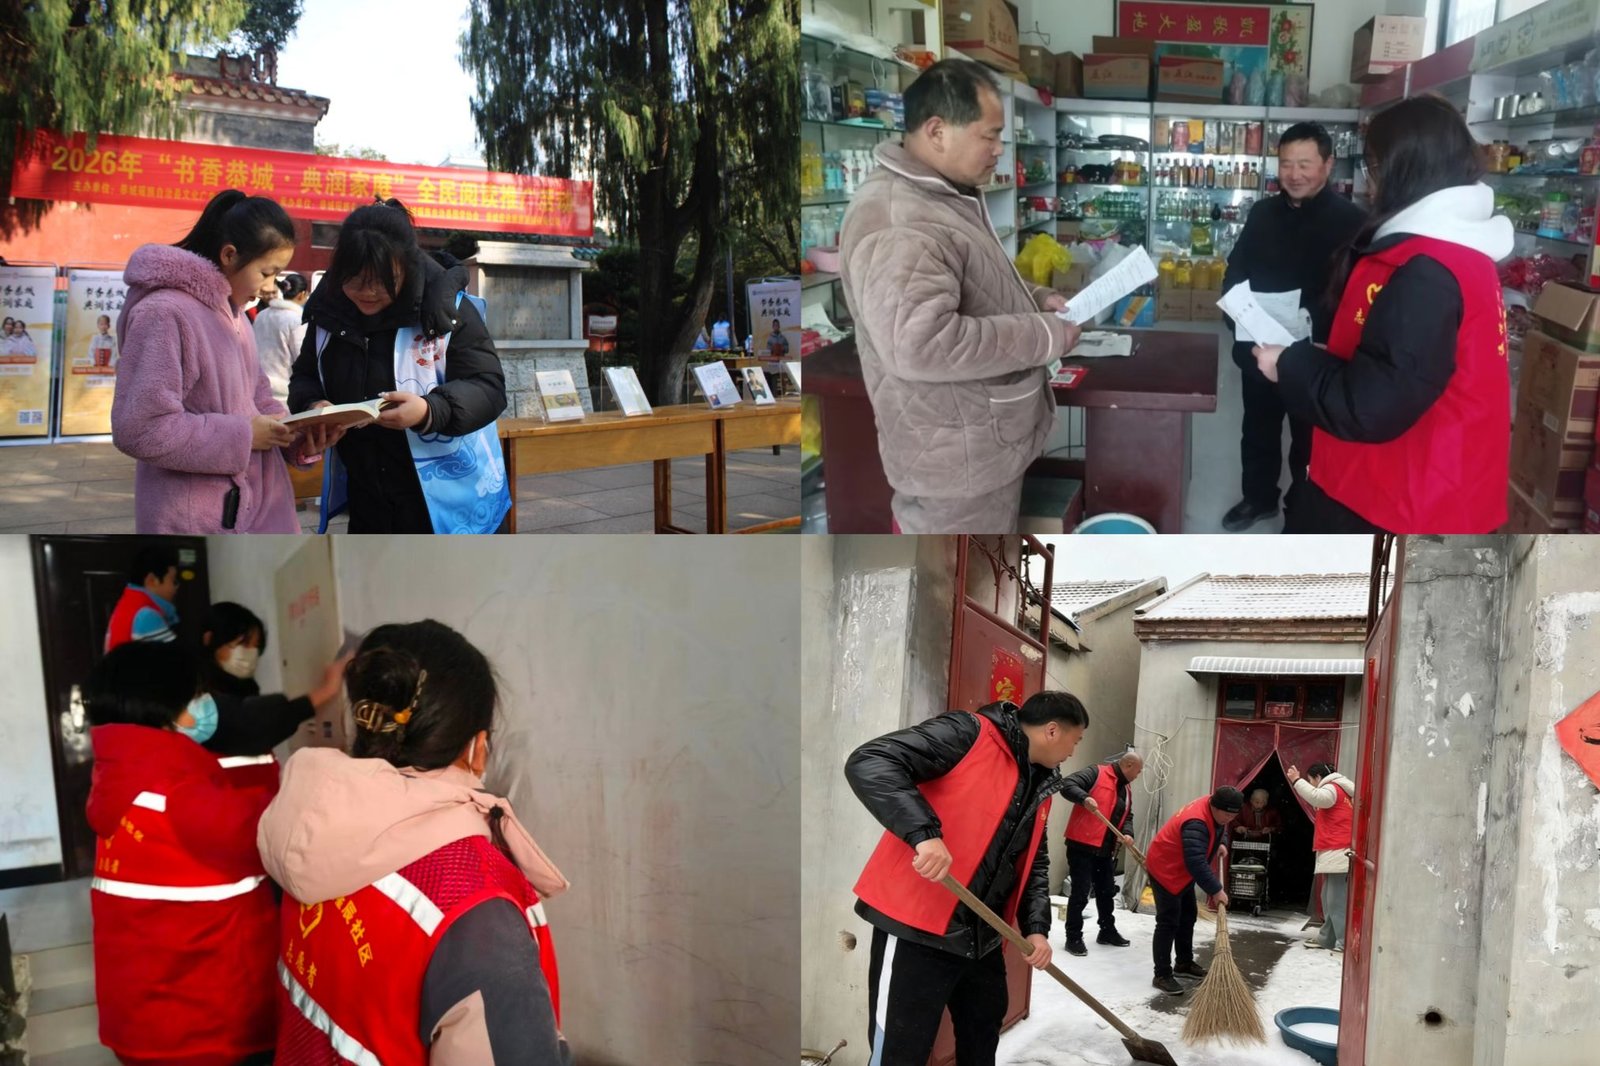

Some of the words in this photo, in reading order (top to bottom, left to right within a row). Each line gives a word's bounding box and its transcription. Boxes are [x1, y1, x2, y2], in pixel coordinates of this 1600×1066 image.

[51, 145, 144, 181] 2026年
[158, 152, 405, 199] “书香恭城·典润家庭”
[416, 176, 574, 214] 全民阅读推广活动
[286, 938, 317, 989] 志愿者
